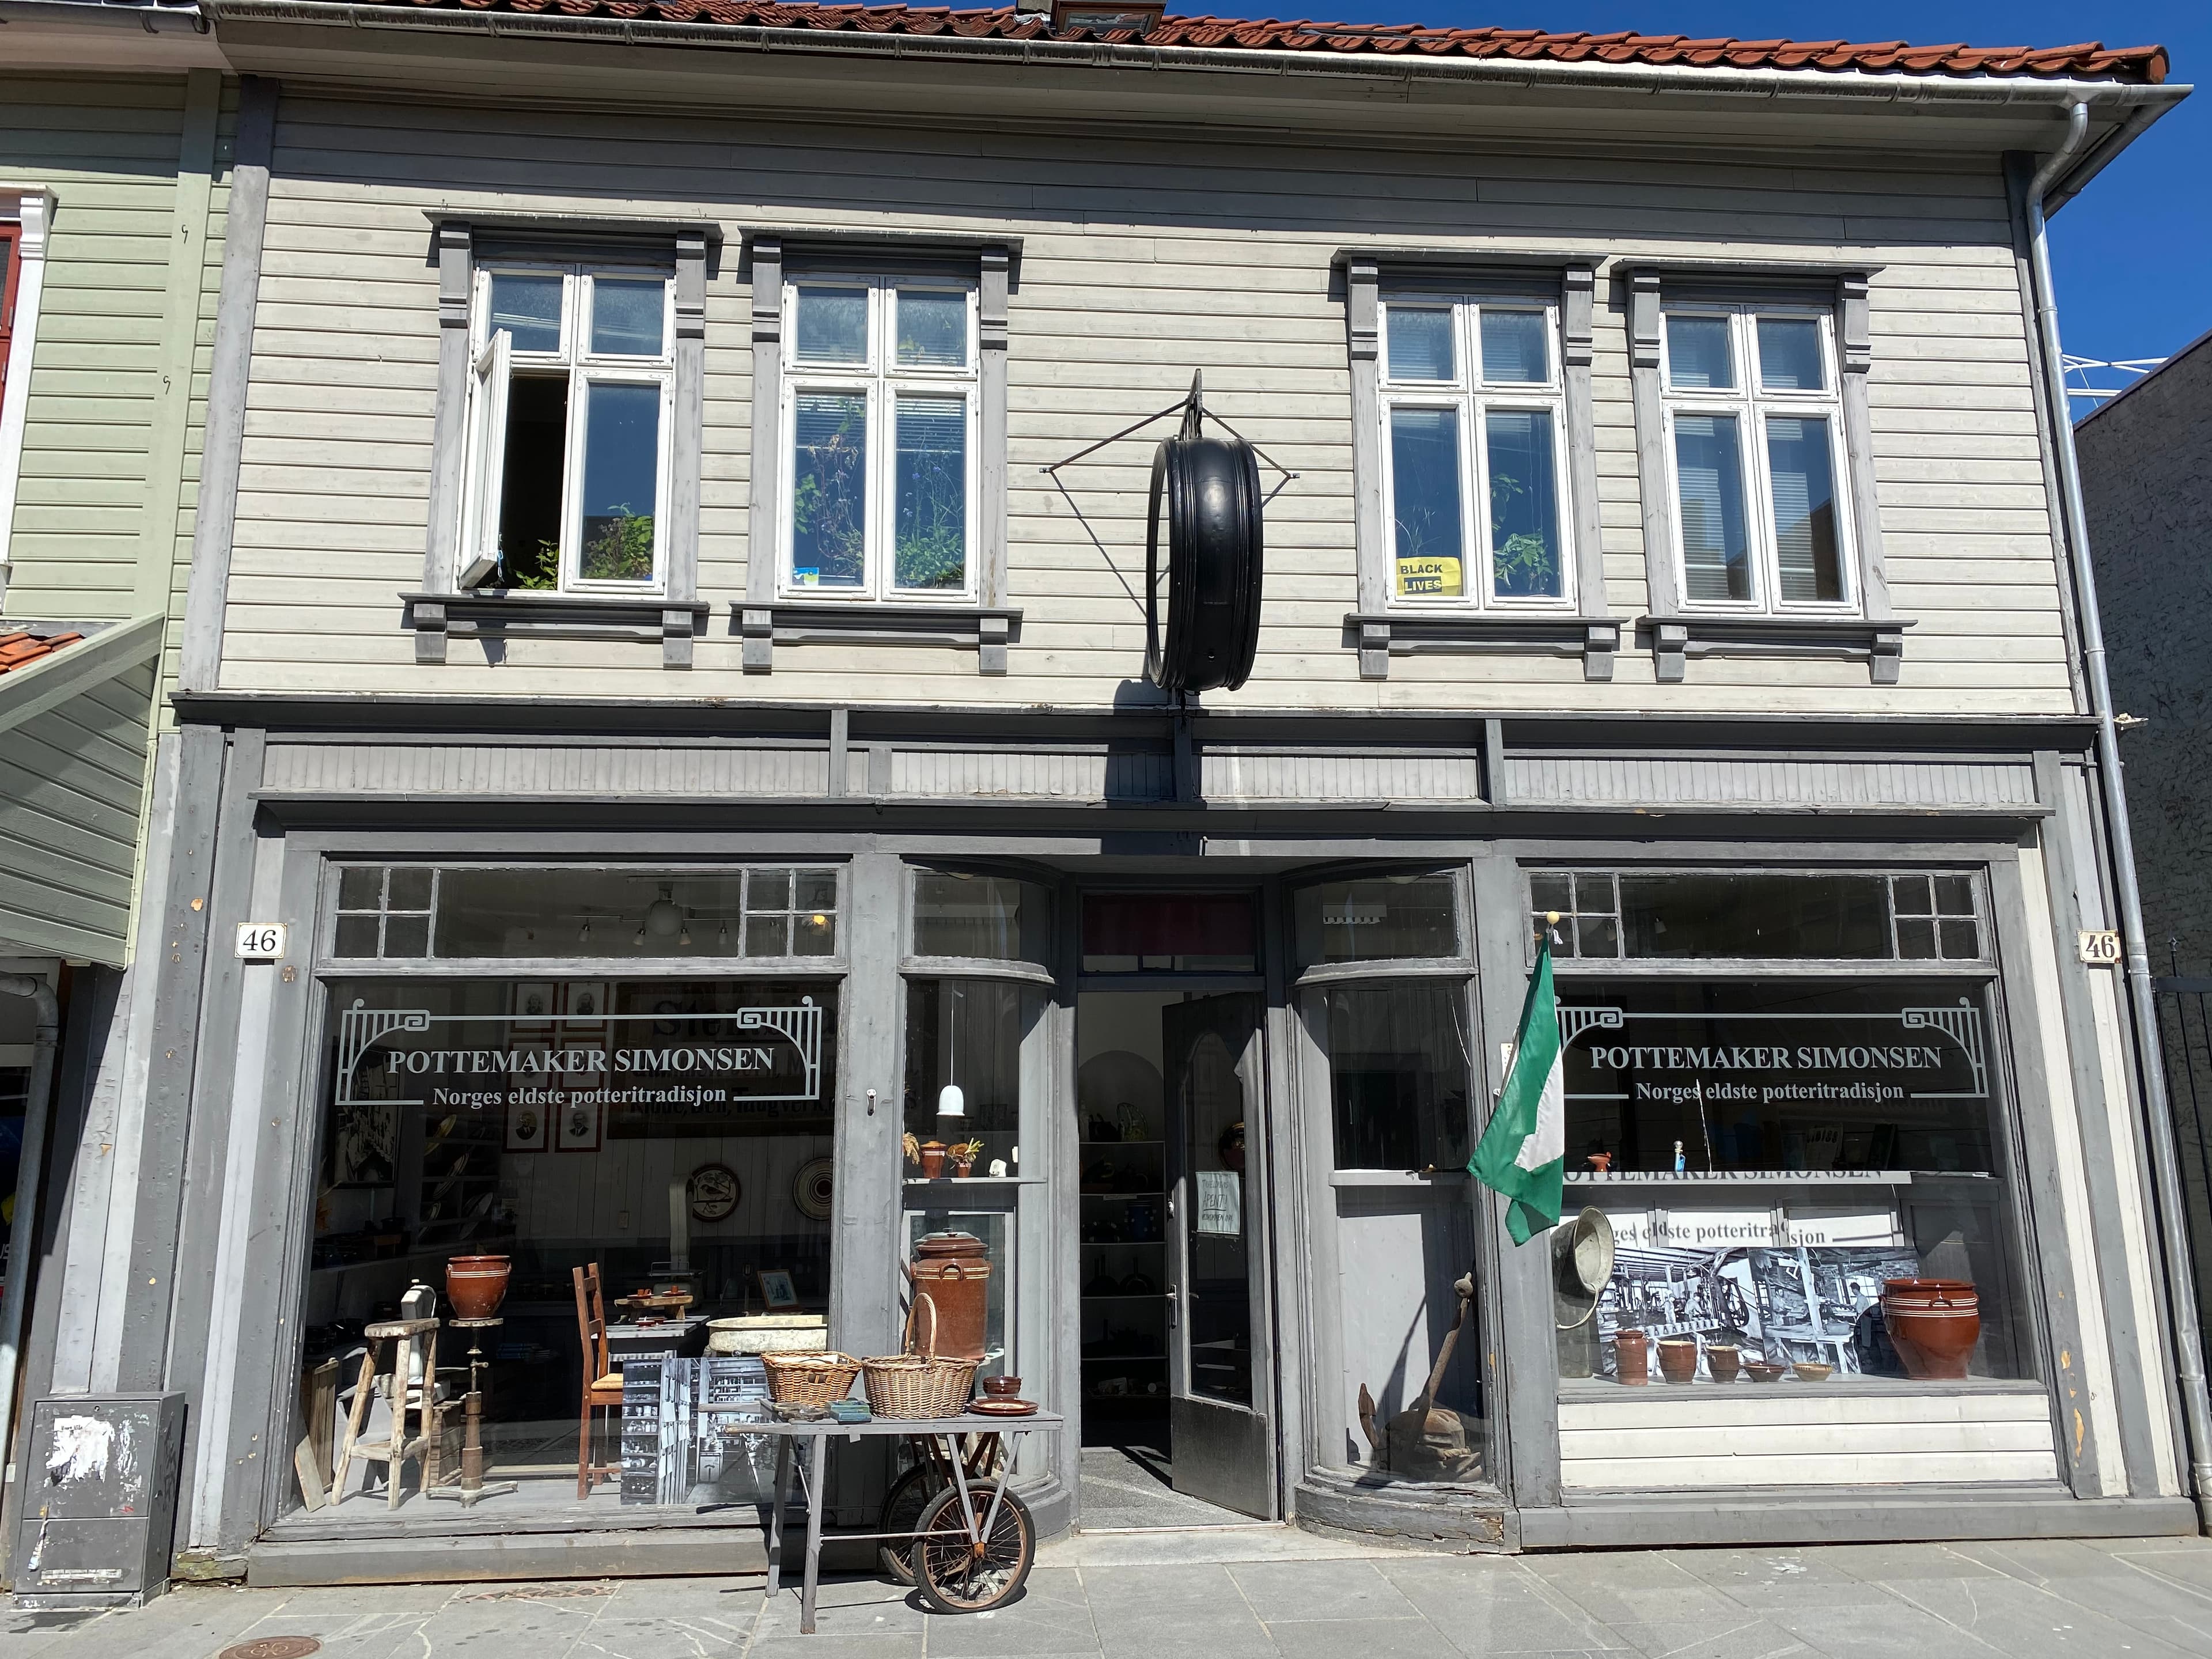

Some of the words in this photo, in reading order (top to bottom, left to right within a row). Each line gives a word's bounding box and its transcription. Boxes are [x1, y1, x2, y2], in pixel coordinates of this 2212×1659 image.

[1400, 564, 1442, 574] BLACK
[1404, 579, 1442, 592] LIVES
[243, 929, 276, 952] 46
[2085, 935, 2115, 958] 46
[387, 1048, 608, 1074] POTTEMAKER
[615, 1047, 775, 1072] SIMONSEN
[1590, 1047, 1793, 1069] POTTEMAKER
[1797, 1047, 1942, 1069] SIMONSEN
[433, 1088, 502, 1109] Norges
[508, 1087, 565, 1104] eldste
[570, 1085, 726, 1108] potteritradisjon
[1636, 1082, 1700, 1104] Norges
[1706, 1083, 1757, 1100] eldste
[1762, 1083, 1904, 1104] potteritradisjon
